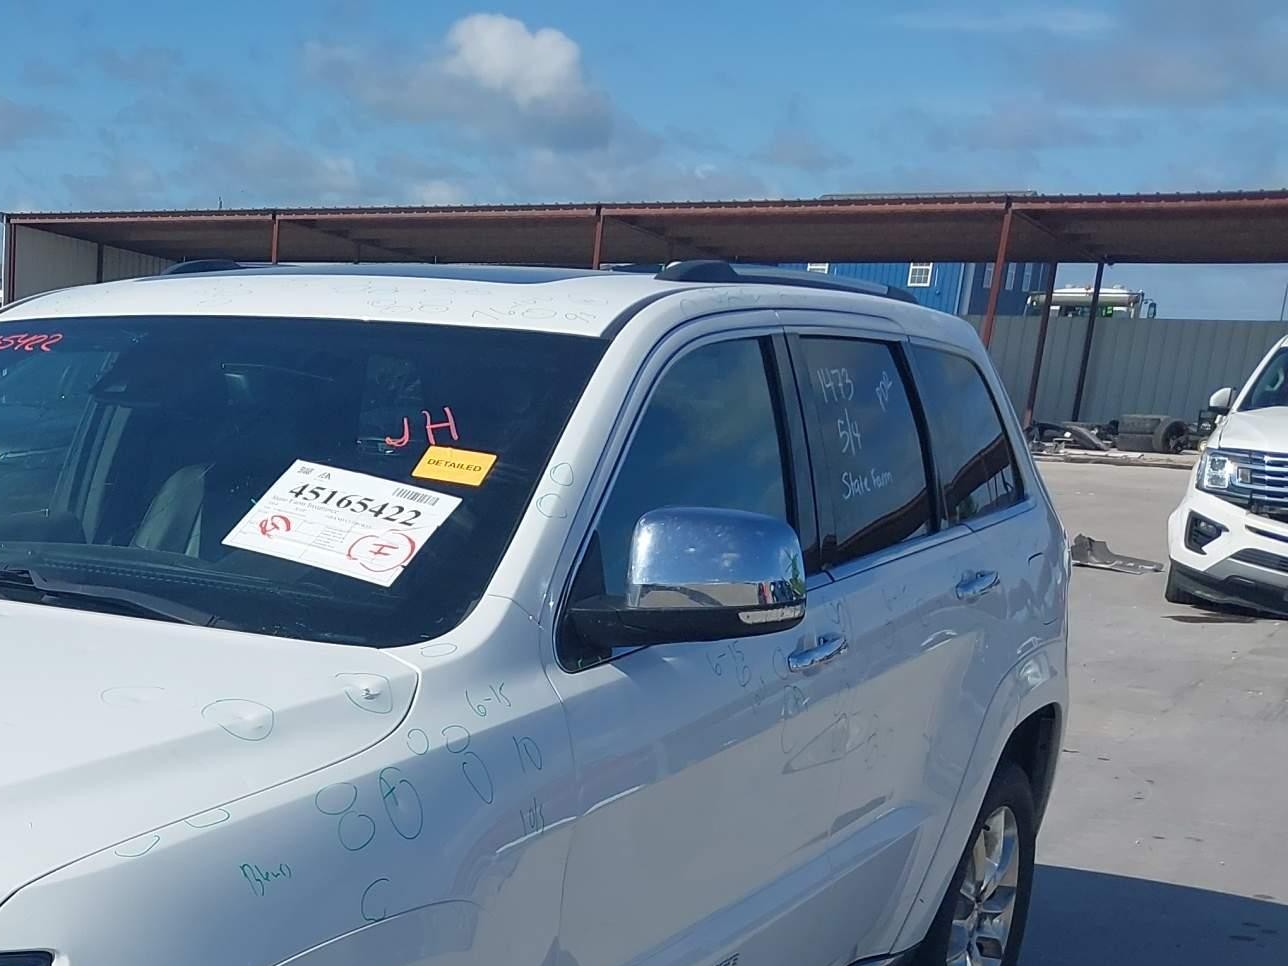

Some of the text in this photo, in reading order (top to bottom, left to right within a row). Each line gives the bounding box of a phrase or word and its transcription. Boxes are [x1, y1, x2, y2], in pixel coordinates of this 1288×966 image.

[817, 367, 855, 403] 1473
[427, 458, 482, 472] DETAILED
[289, 483, 422, 527] 45165422
